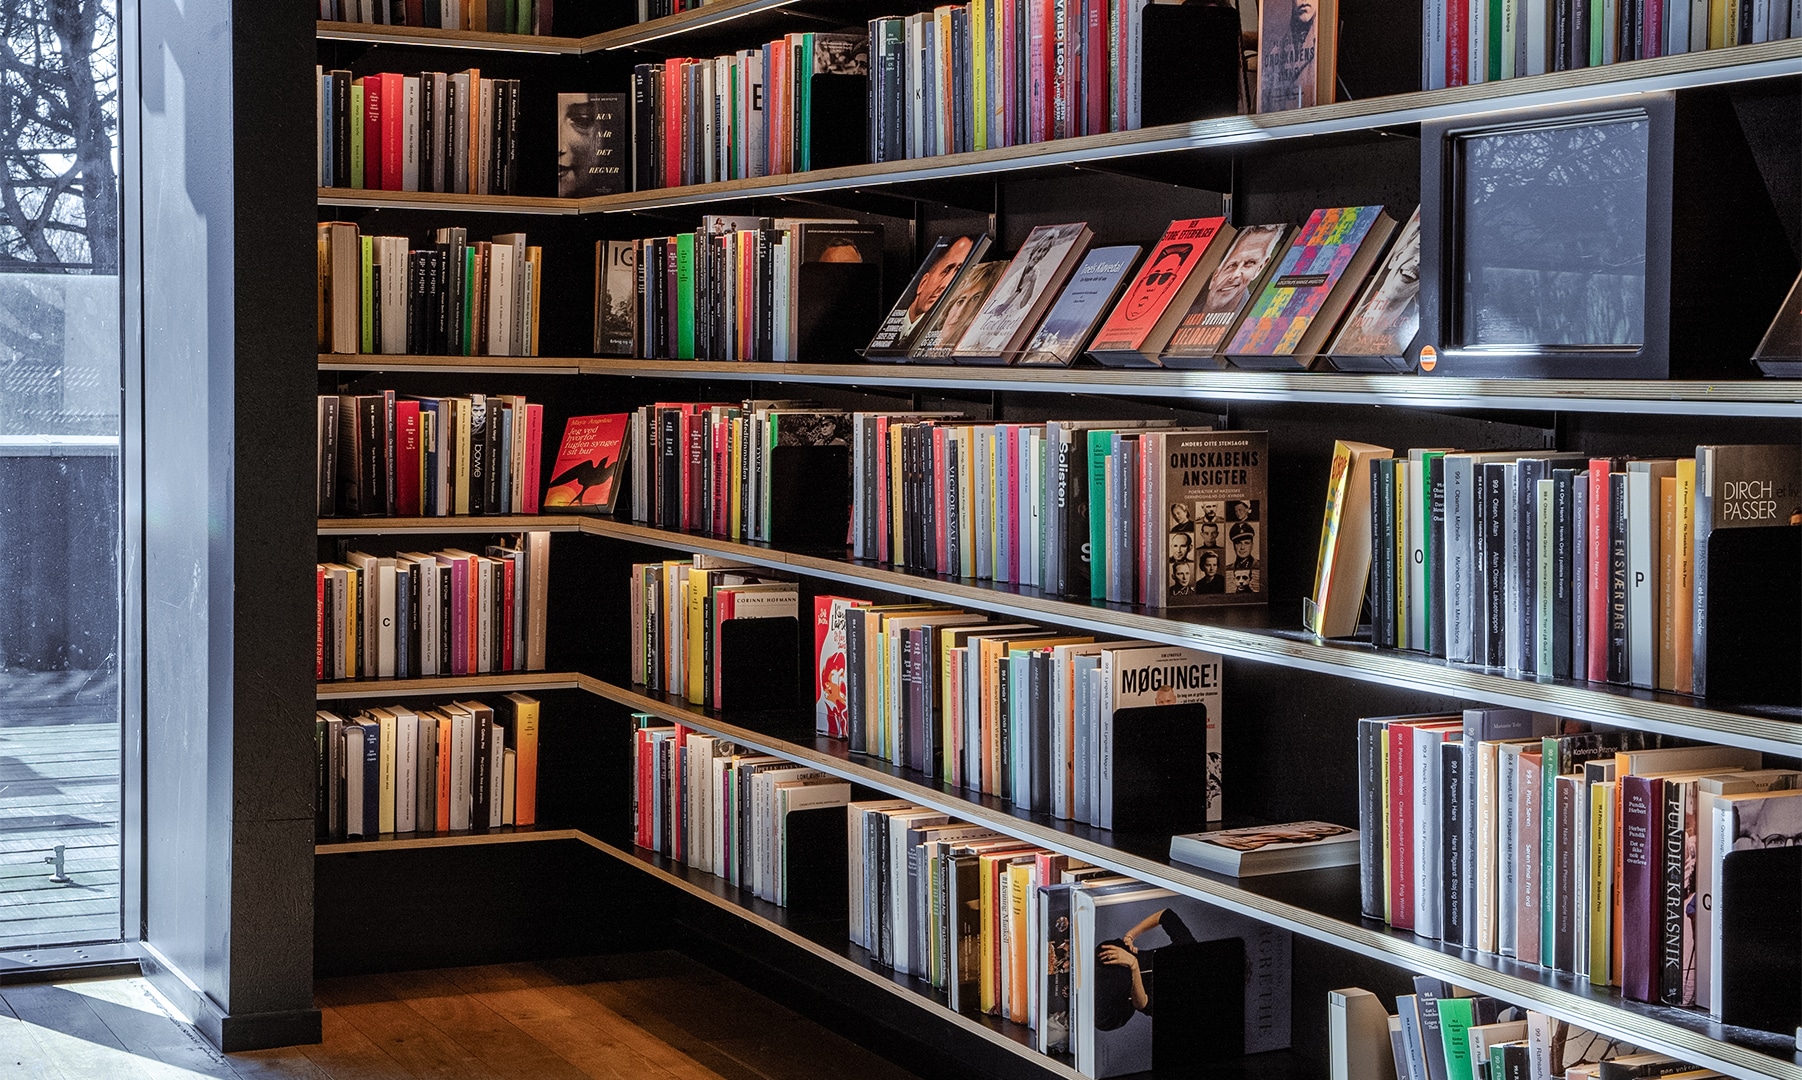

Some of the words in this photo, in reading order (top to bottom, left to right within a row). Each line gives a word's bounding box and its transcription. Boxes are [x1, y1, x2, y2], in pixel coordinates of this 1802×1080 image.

[753, 84, 762, 110] E
[1163, 232, 1178, 241] STORE
[1179, 228, 1214, 238] EFTERFØLGER
[1202, 312, 1235, 325] SURVIVOR
[473, 444, 482, 477] bowie
[1171, 452, 1258, 468] ONDSKABENS
[1058, 442, 1068, 508] Solisten
[1183, 470, 1246, 486] ANSIGTER
[1724, 481, 1772, 500] DIRCH
[1724, 501, 1776, 520] PASSER
[1615, 540, 1624, 556] EN
[1615, 561, 1624, 598] SVÆR
[1636, 572, 1645, 587] P
[1615, 604, 1624, 629] DAG
[1122, 664, 1218, 696] MØGUNGE!
[1667, 799, 1681, 874] PUNDIK
[1000, 876, 1009, 913] #Henning
[1665, 883, 1681, 968] KRASNIK
